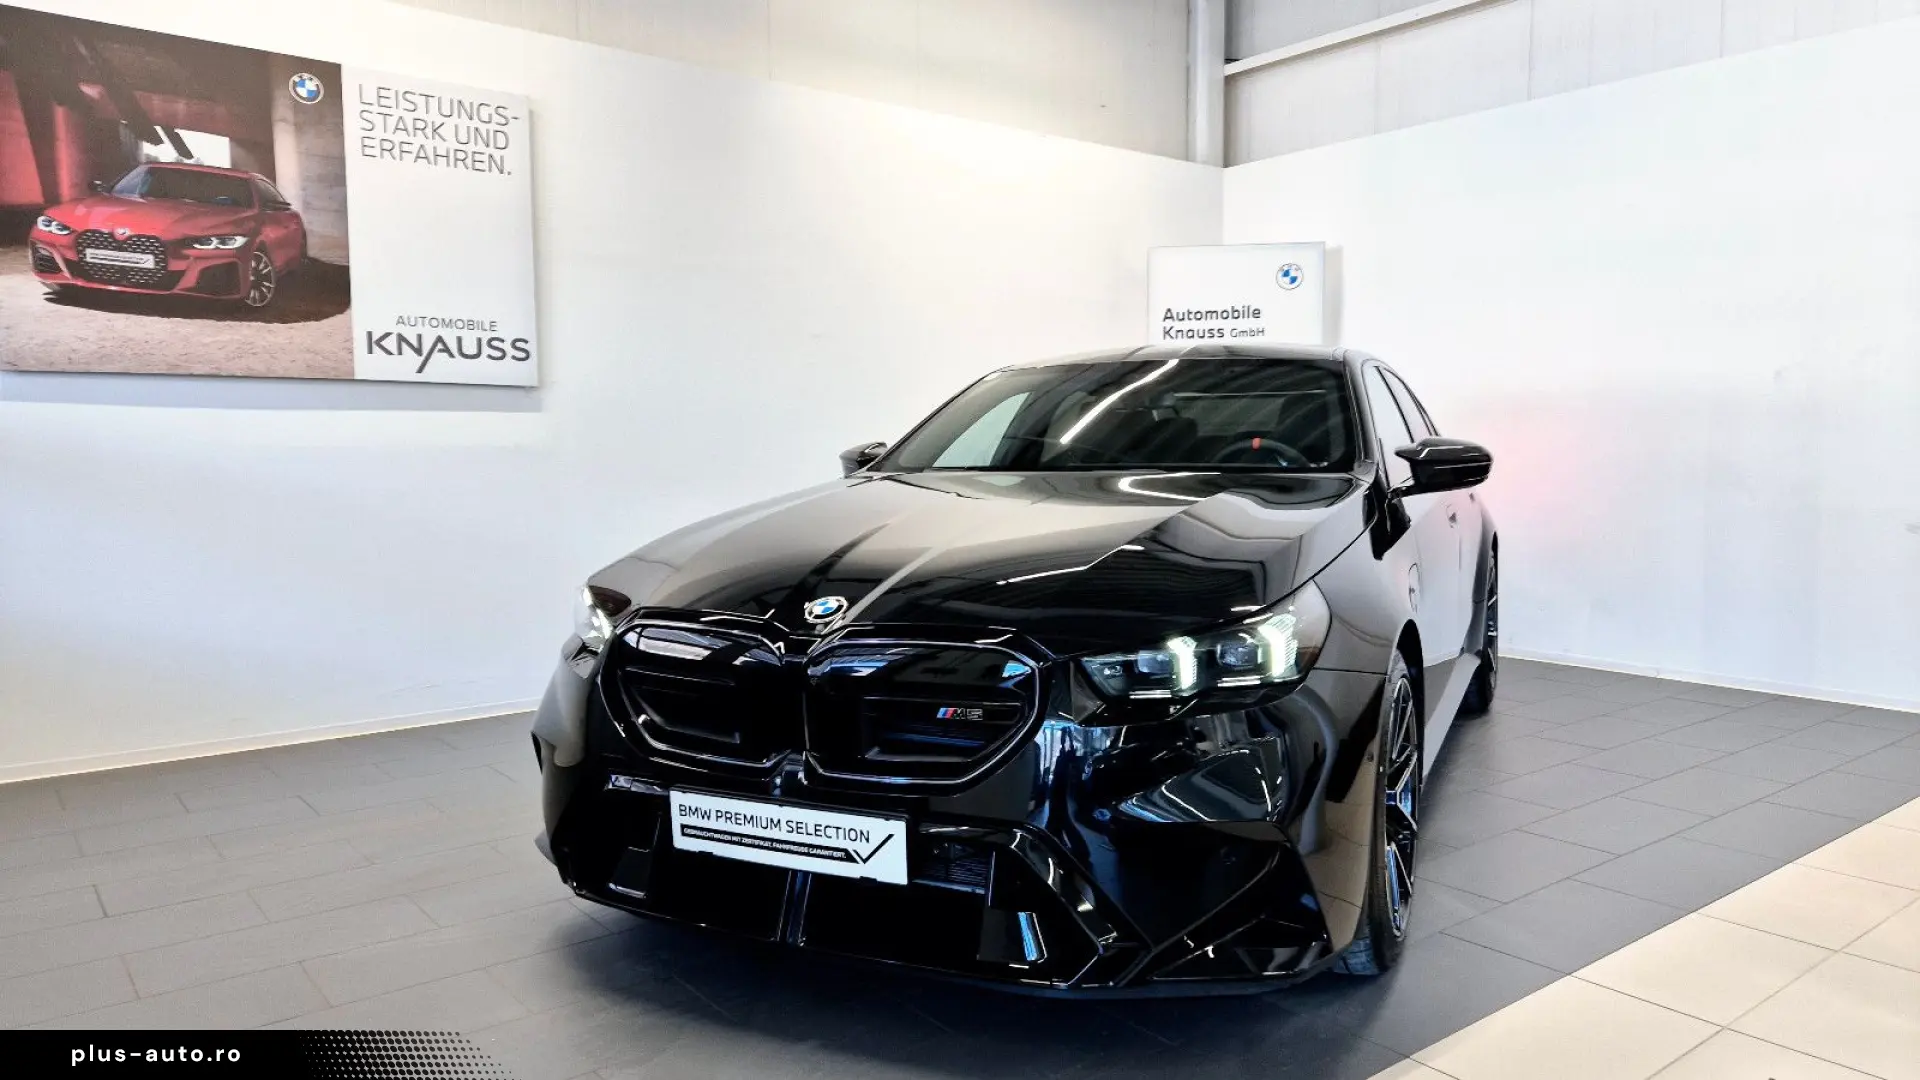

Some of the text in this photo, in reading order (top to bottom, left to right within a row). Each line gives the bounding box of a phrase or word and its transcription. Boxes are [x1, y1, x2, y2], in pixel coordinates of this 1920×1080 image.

[358, 83, 520, 127] LEISTUNGS-
[359, 109, 510, 150] STARK UND
[360, 135, 512, 176] ERFAHREN.
[395, 315, 498, 332] AUTOMOBILE
[1162, 305, 1261, 322] Automobile
[1162, 326, 1265, 340] Knauss GmbH
[366, 330, 530, 374] KNAUSS
[679, 803, 870, 844] BMW PREMIUM SELECTION
